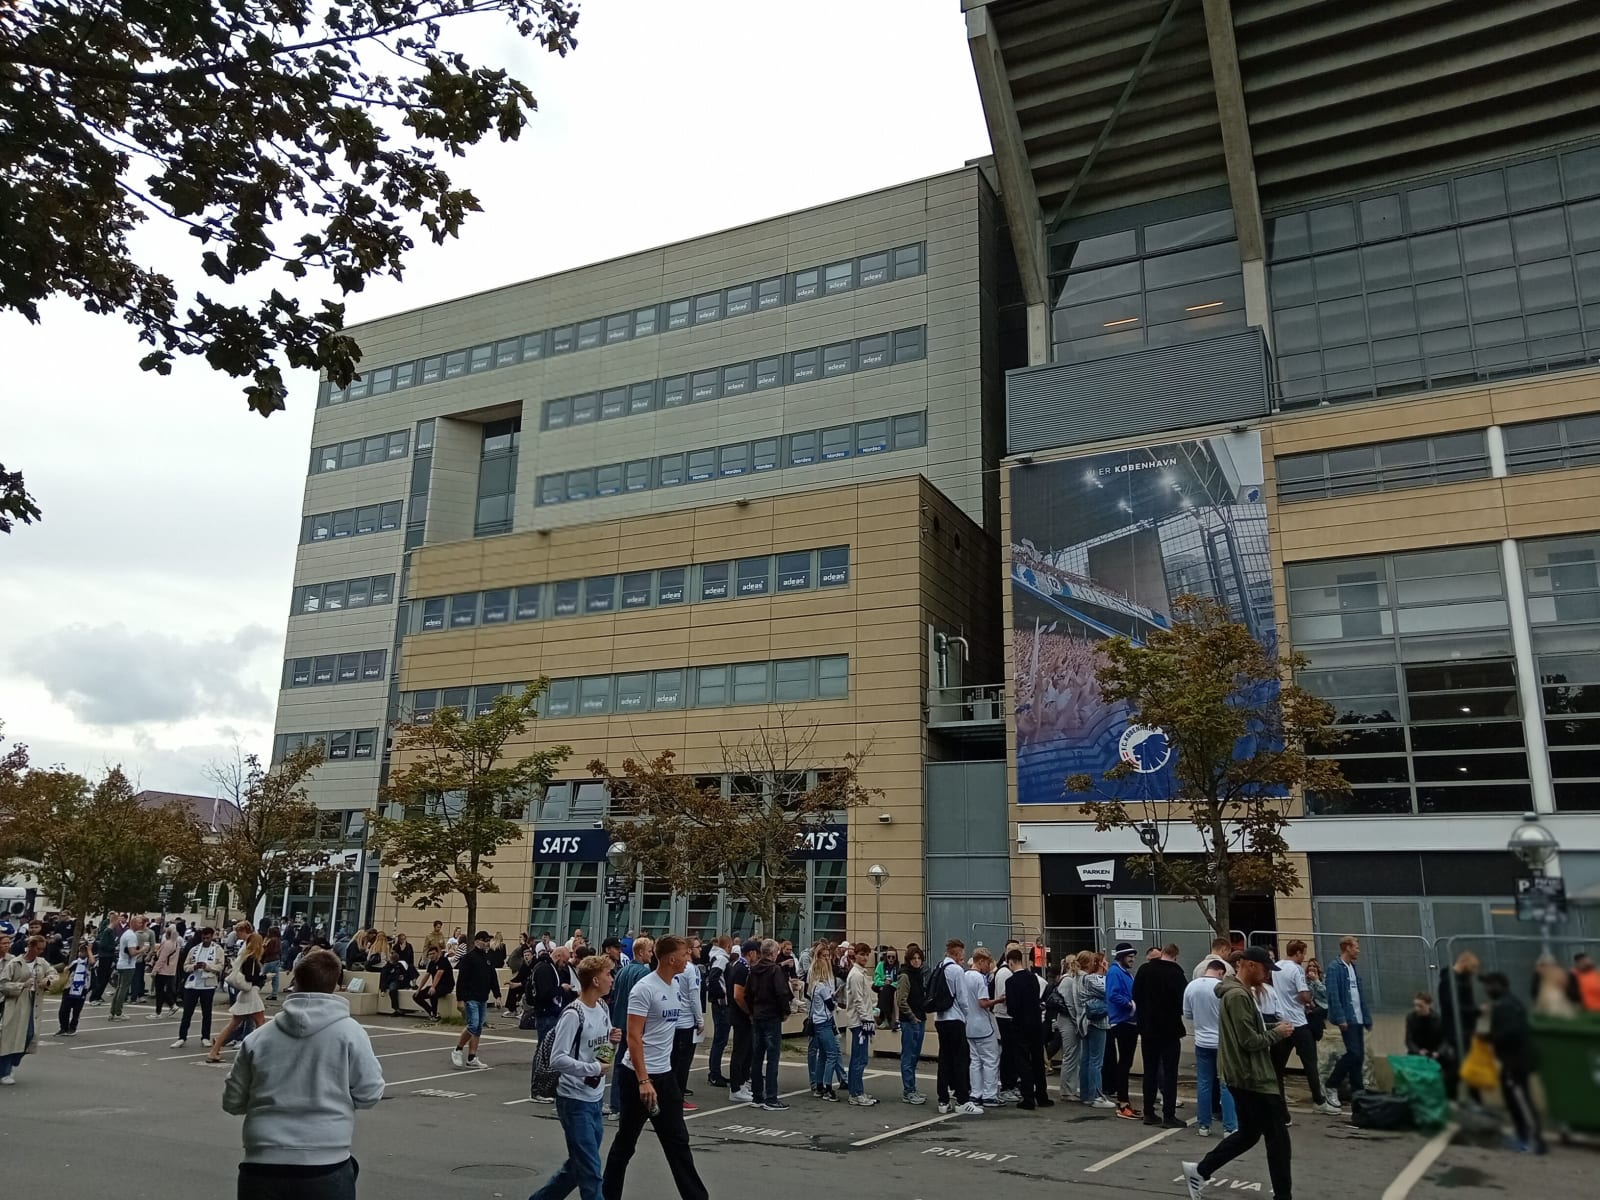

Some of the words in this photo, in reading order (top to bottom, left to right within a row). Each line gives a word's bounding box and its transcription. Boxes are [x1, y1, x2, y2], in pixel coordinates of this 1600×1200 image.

[864, 272, 882, 281] adeas
[830, 280, 848, 289] adeas
[797, 287, 815, 297] adeas
[863, 354, 882, 363] adeas
[1099, 467, 1112, 476] ER
[1114, 458, 1177, 473] KØBENHAVN
[783, 576, 806, 586] adeas
[823, 571, 846, 581] adeas
[705, 585, 726, 595] adeas
[743, 581, 764, 591] adeas
[662, 590, 682, 599] adeas
[621, 696, 641, 704] adeas
[657, 693, 678, 702] adeas
[540, 836, 581, 854] SATS
[608, 877, 614, 885] P
[1518, 880, 1530, 893] P
[718, 1125, 803, 1138] PRIVAT
[921, 1147, 1018, 1162] PRIVAT
